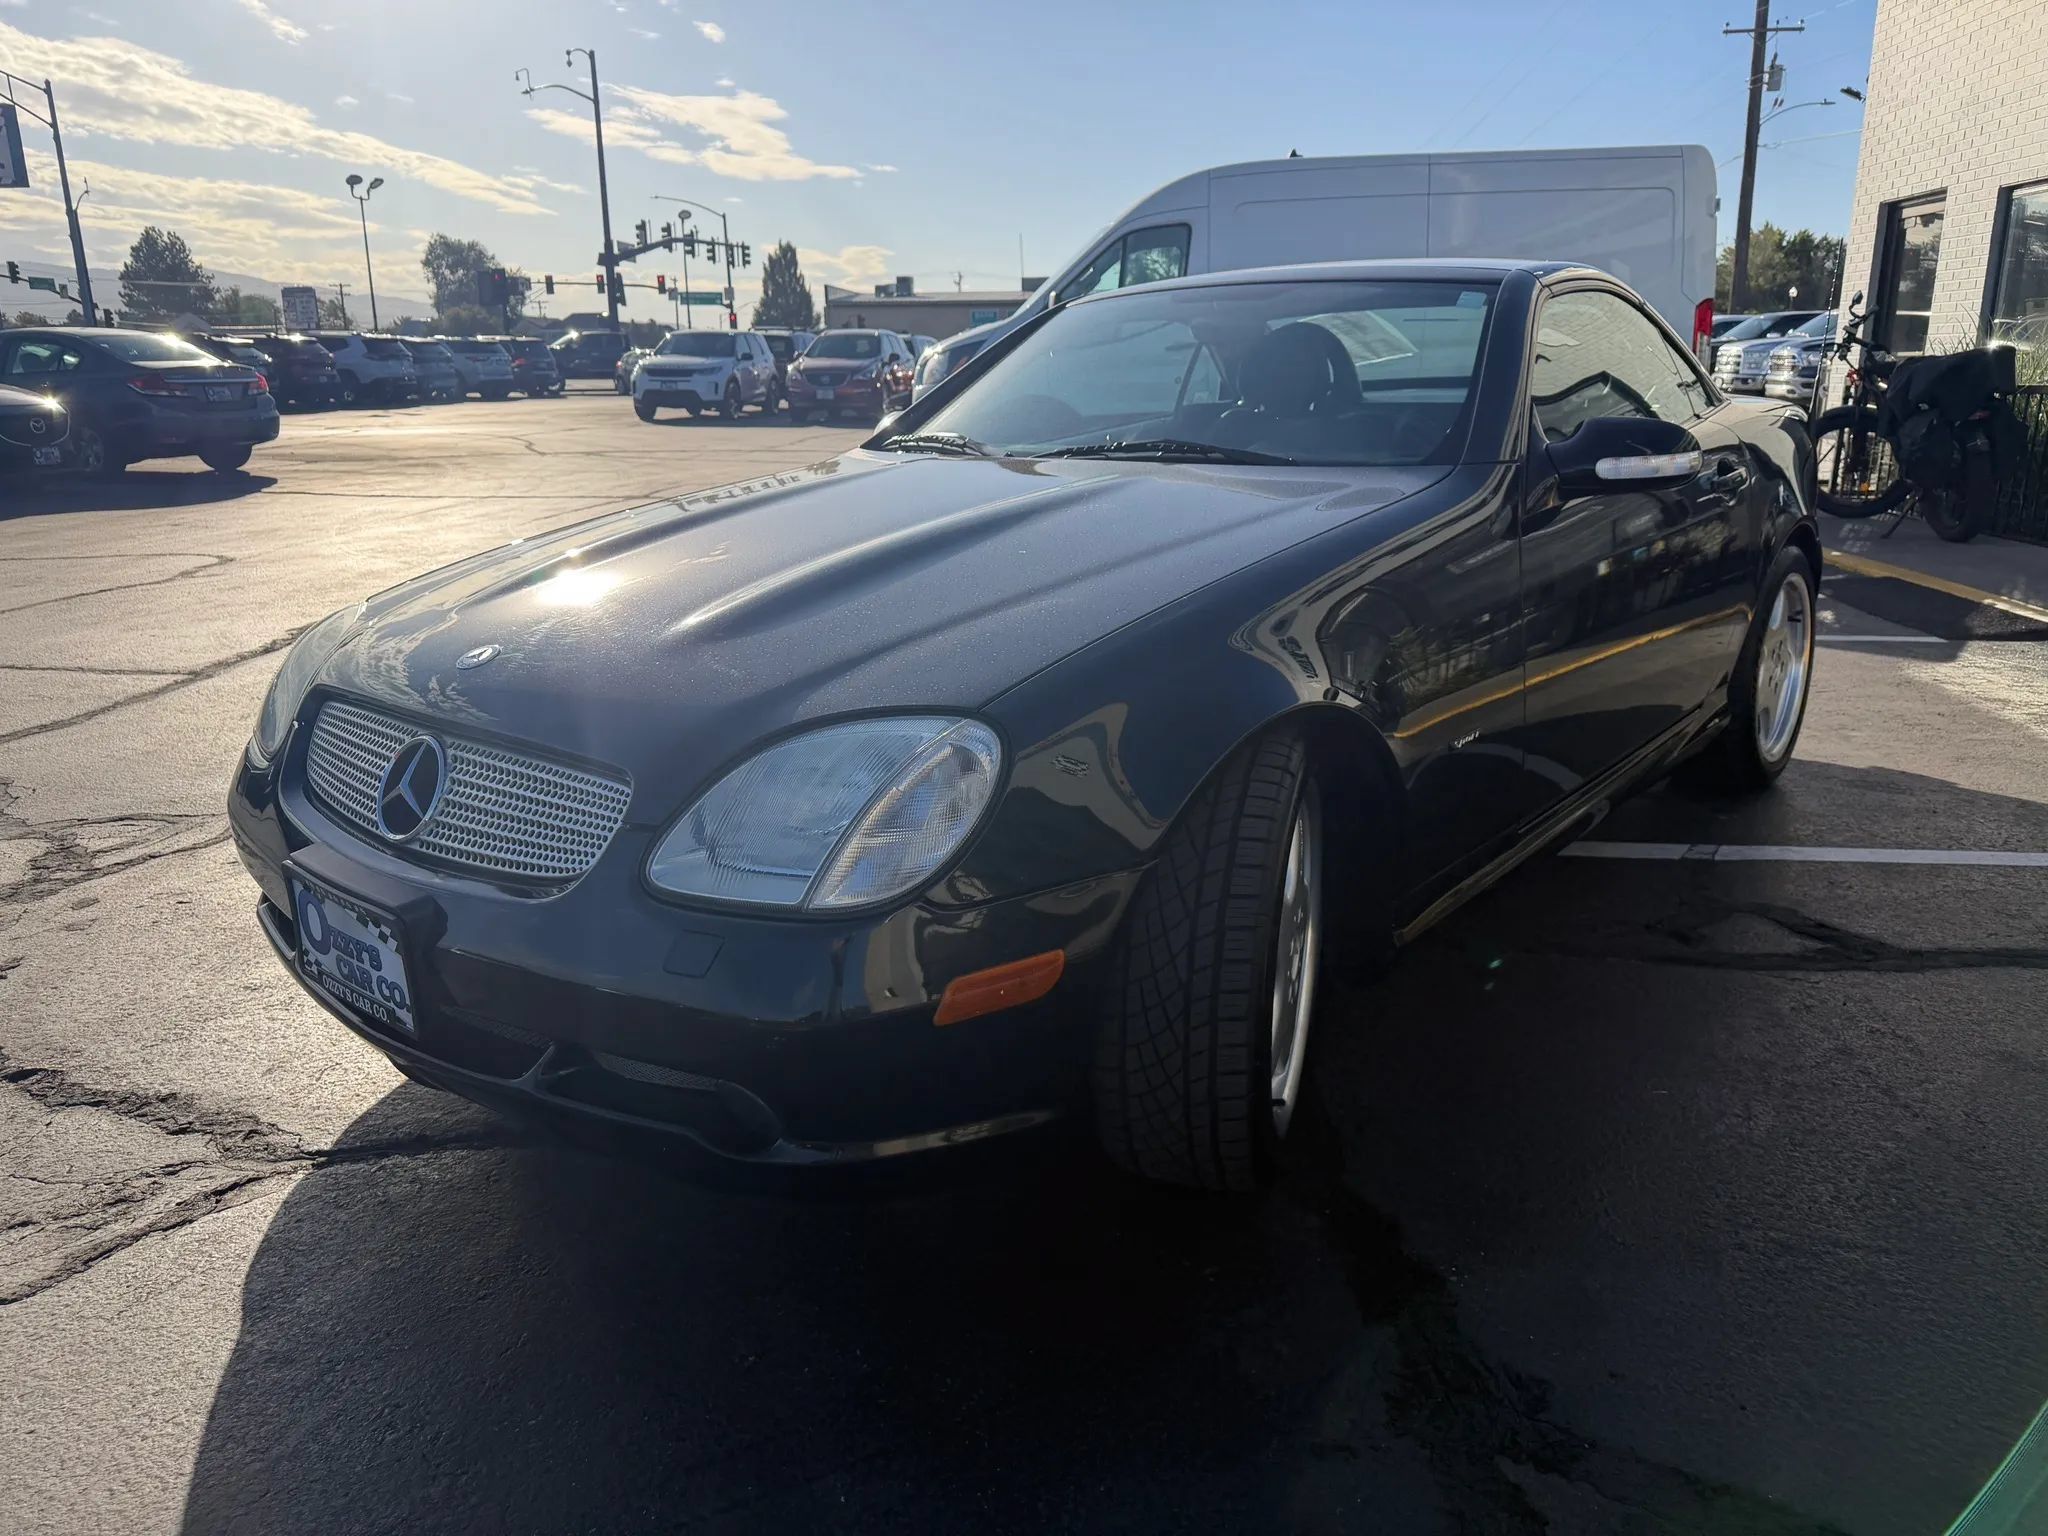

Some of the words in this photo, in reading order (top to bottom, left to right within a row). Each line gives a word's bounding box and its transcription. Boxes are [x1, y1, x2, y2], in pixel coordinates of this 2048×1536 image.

[322, 974, 352, 1003] OZZY'S
[352, 992, 373, 1014] CAR
[373, 1003, 390, 1024] CO.
[336, 954, 374, 995] CAR
[376, 975, 411, 1014] CO.
